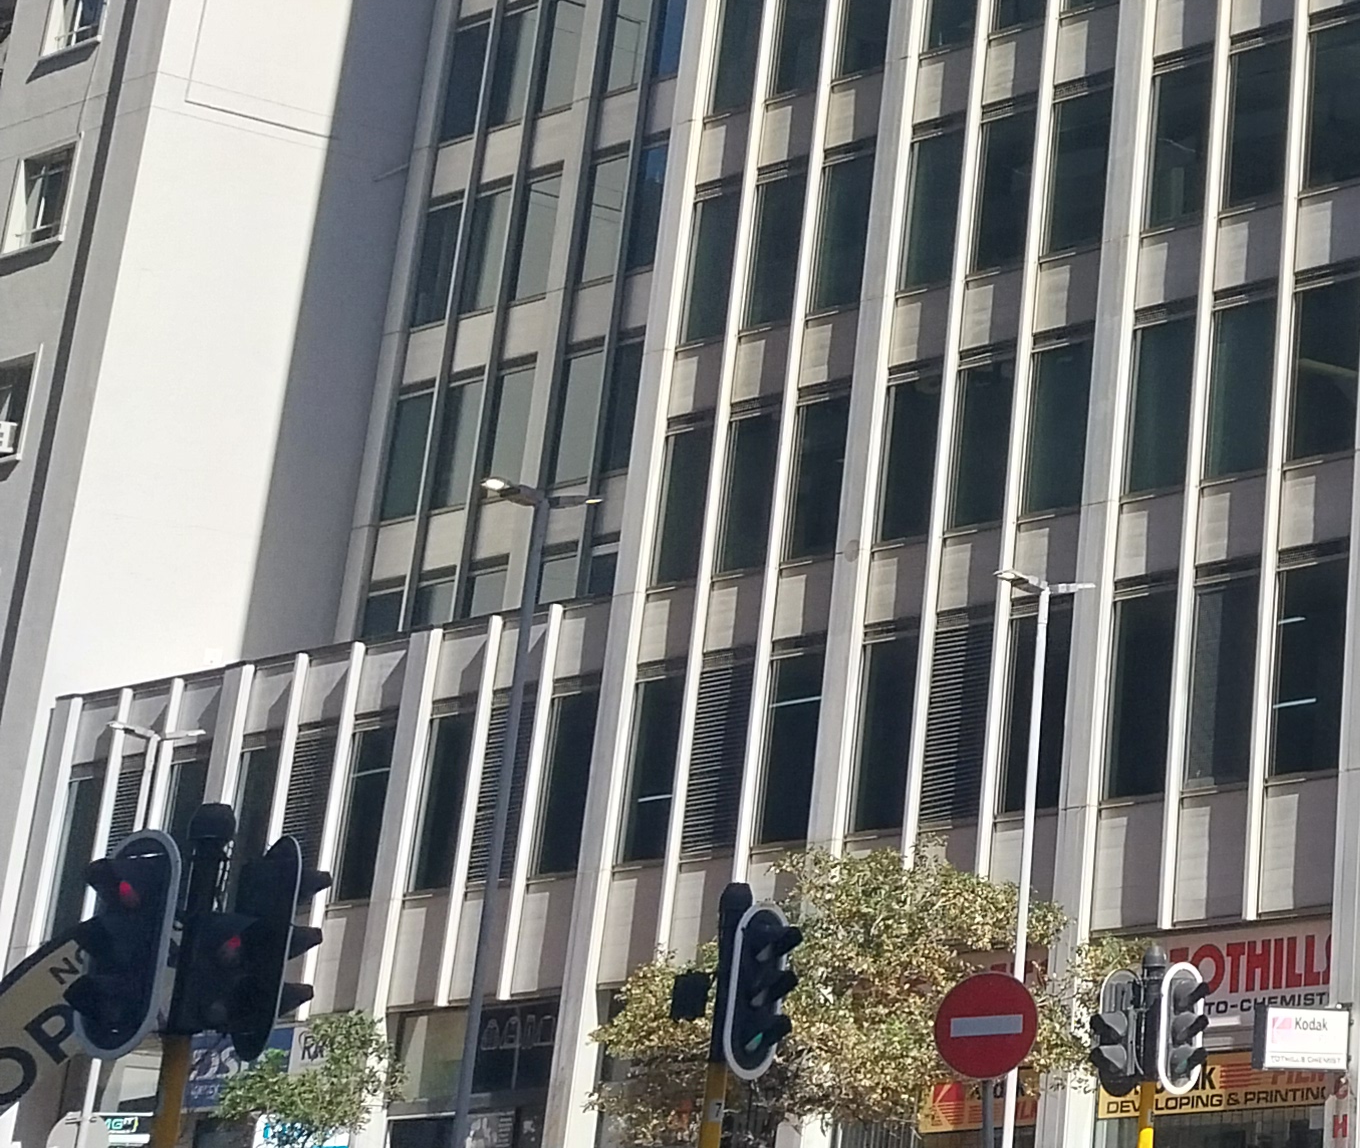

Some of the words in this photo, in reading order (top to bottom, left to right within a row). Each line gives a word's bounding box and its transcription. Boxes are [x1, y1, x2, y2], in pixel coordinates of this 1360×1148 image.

[1294, 1016, 1328, 1031] Kodak
[1106, 1091, 1223, 1115] DEVLOPING
[1226, 1090, 1241, 1106] &
